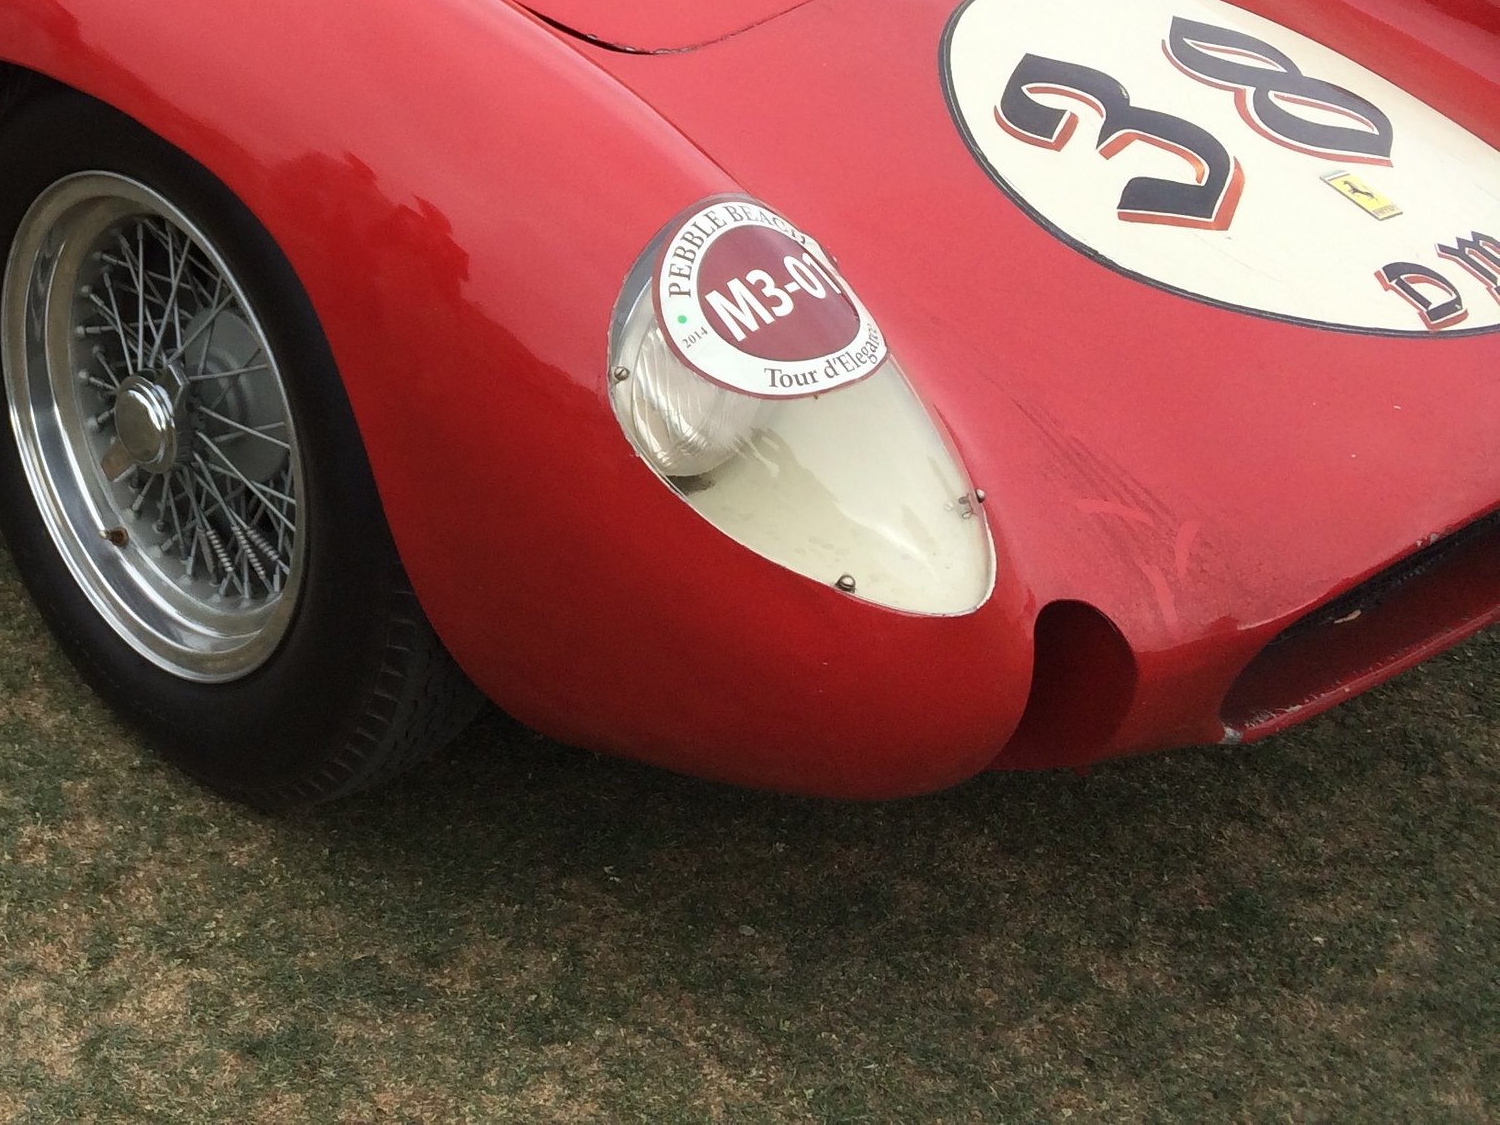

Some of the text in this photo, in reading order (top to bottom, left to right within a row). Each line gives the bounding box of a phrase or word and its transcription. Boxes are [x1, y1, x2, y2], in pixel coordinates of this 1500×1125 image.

[994, 15, 1395, 232] 38
[668, 209, 727, 298] PEBBLE
[704, 251, 842, 342] M3-01
[681, 325, 709, 349] 2014
[763, 322, 880, 389] Tour d'Elegan
